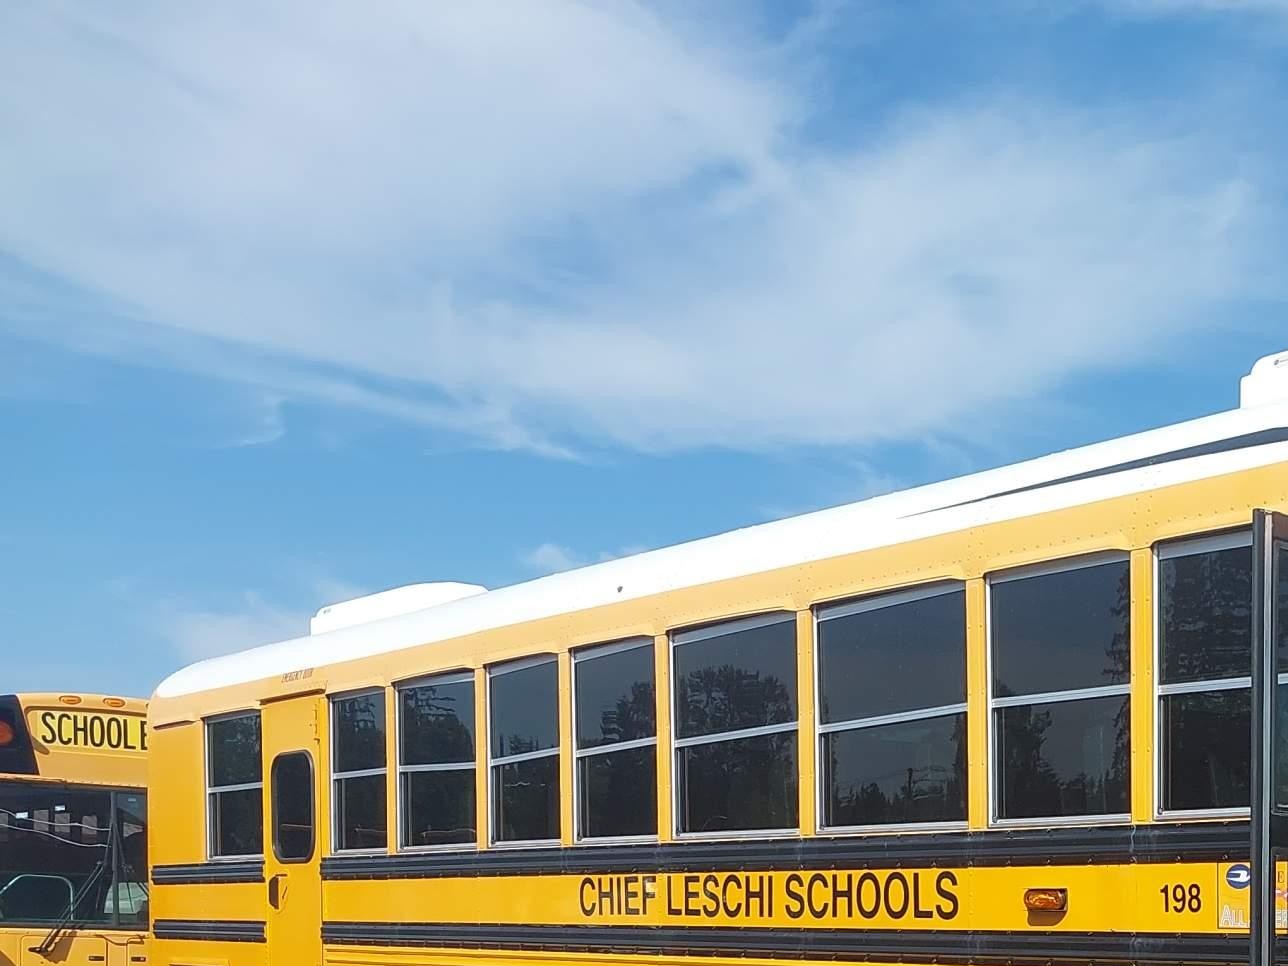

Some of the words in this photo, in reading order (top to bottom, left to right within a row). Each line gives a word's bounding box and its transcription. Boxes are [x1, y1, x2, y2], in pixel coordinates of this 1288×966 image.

[41, 711, 137, 750] SCHOOL
[580, 876, 656, 917] CHIEF
[667, 874, 774, 918] LESCHI
[785, 871, 959, 920] SCHOOLS
[1160, 883, 1201, 913] 198
